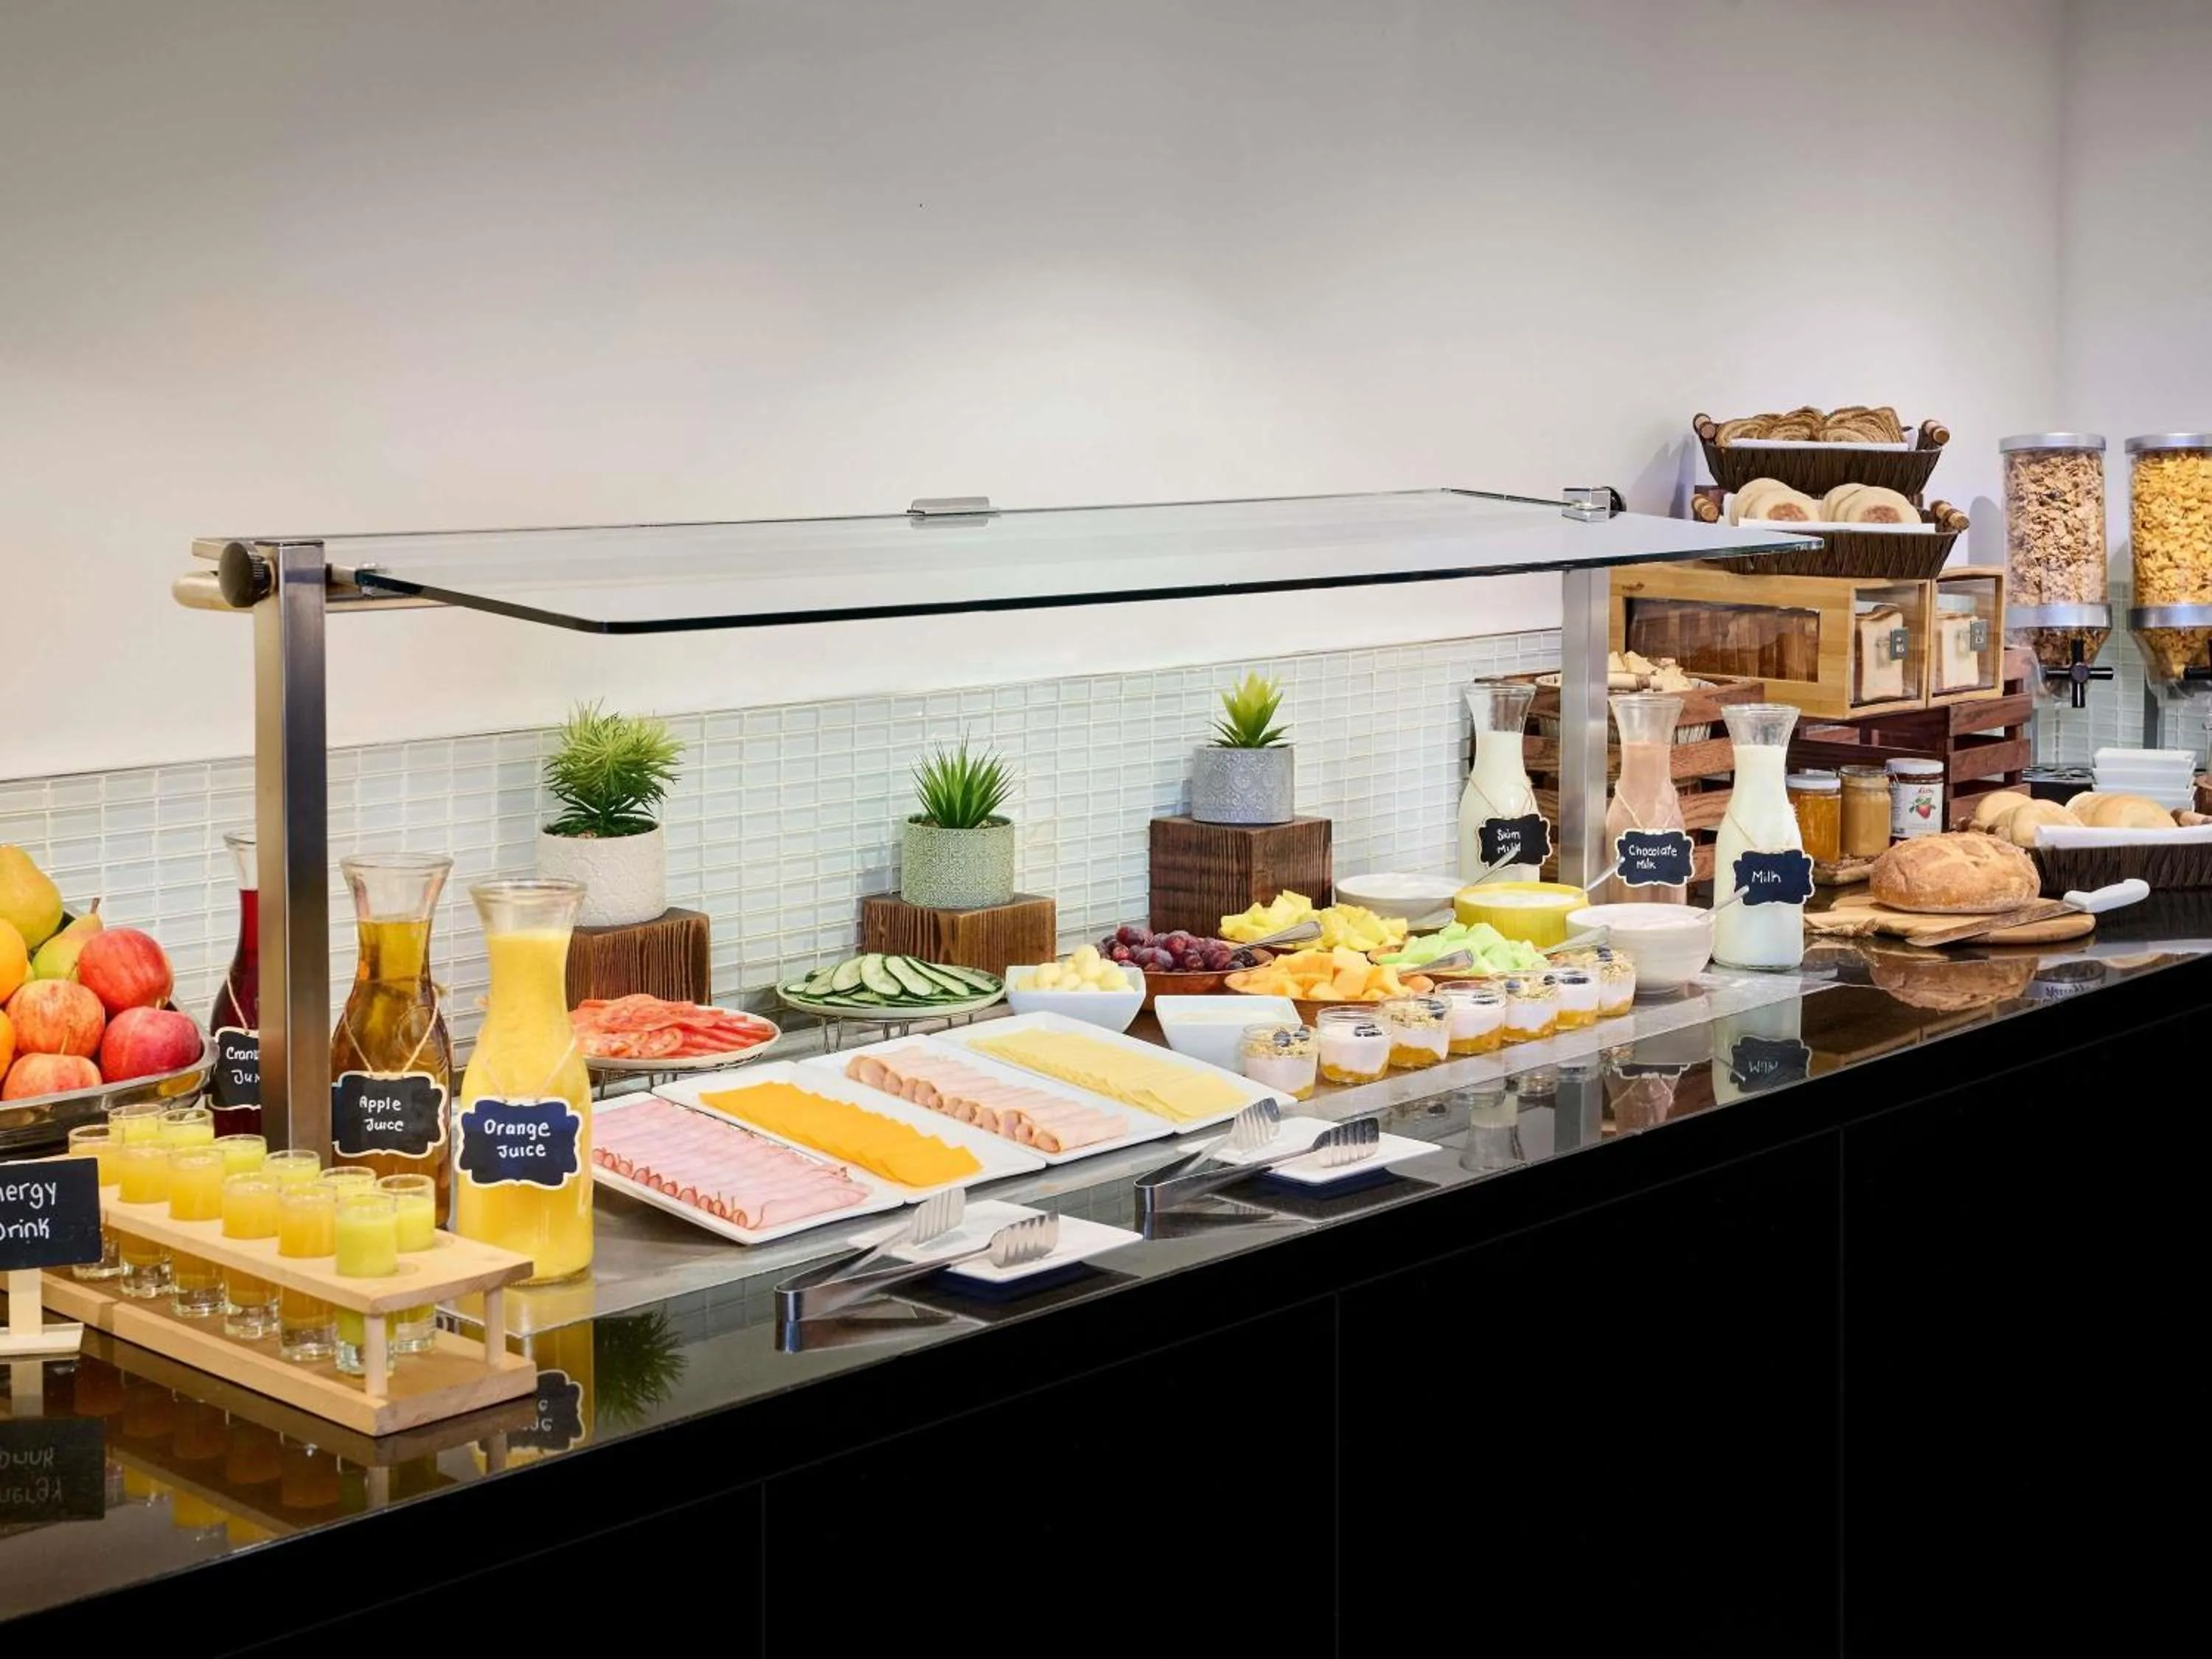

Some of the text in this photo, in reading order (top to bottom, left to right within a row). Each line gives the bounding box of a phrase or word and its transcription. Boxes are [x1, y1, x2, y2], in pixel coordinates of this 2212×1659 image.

[1628, 844, 1677, 857] Chocolate
[359, 1095, 402, 1113] Apple
[364, 1118, 405, 1132] Juice
[484, 1119, 551, 1141] Orange
[496, 1144, 546, 1158] Juice
